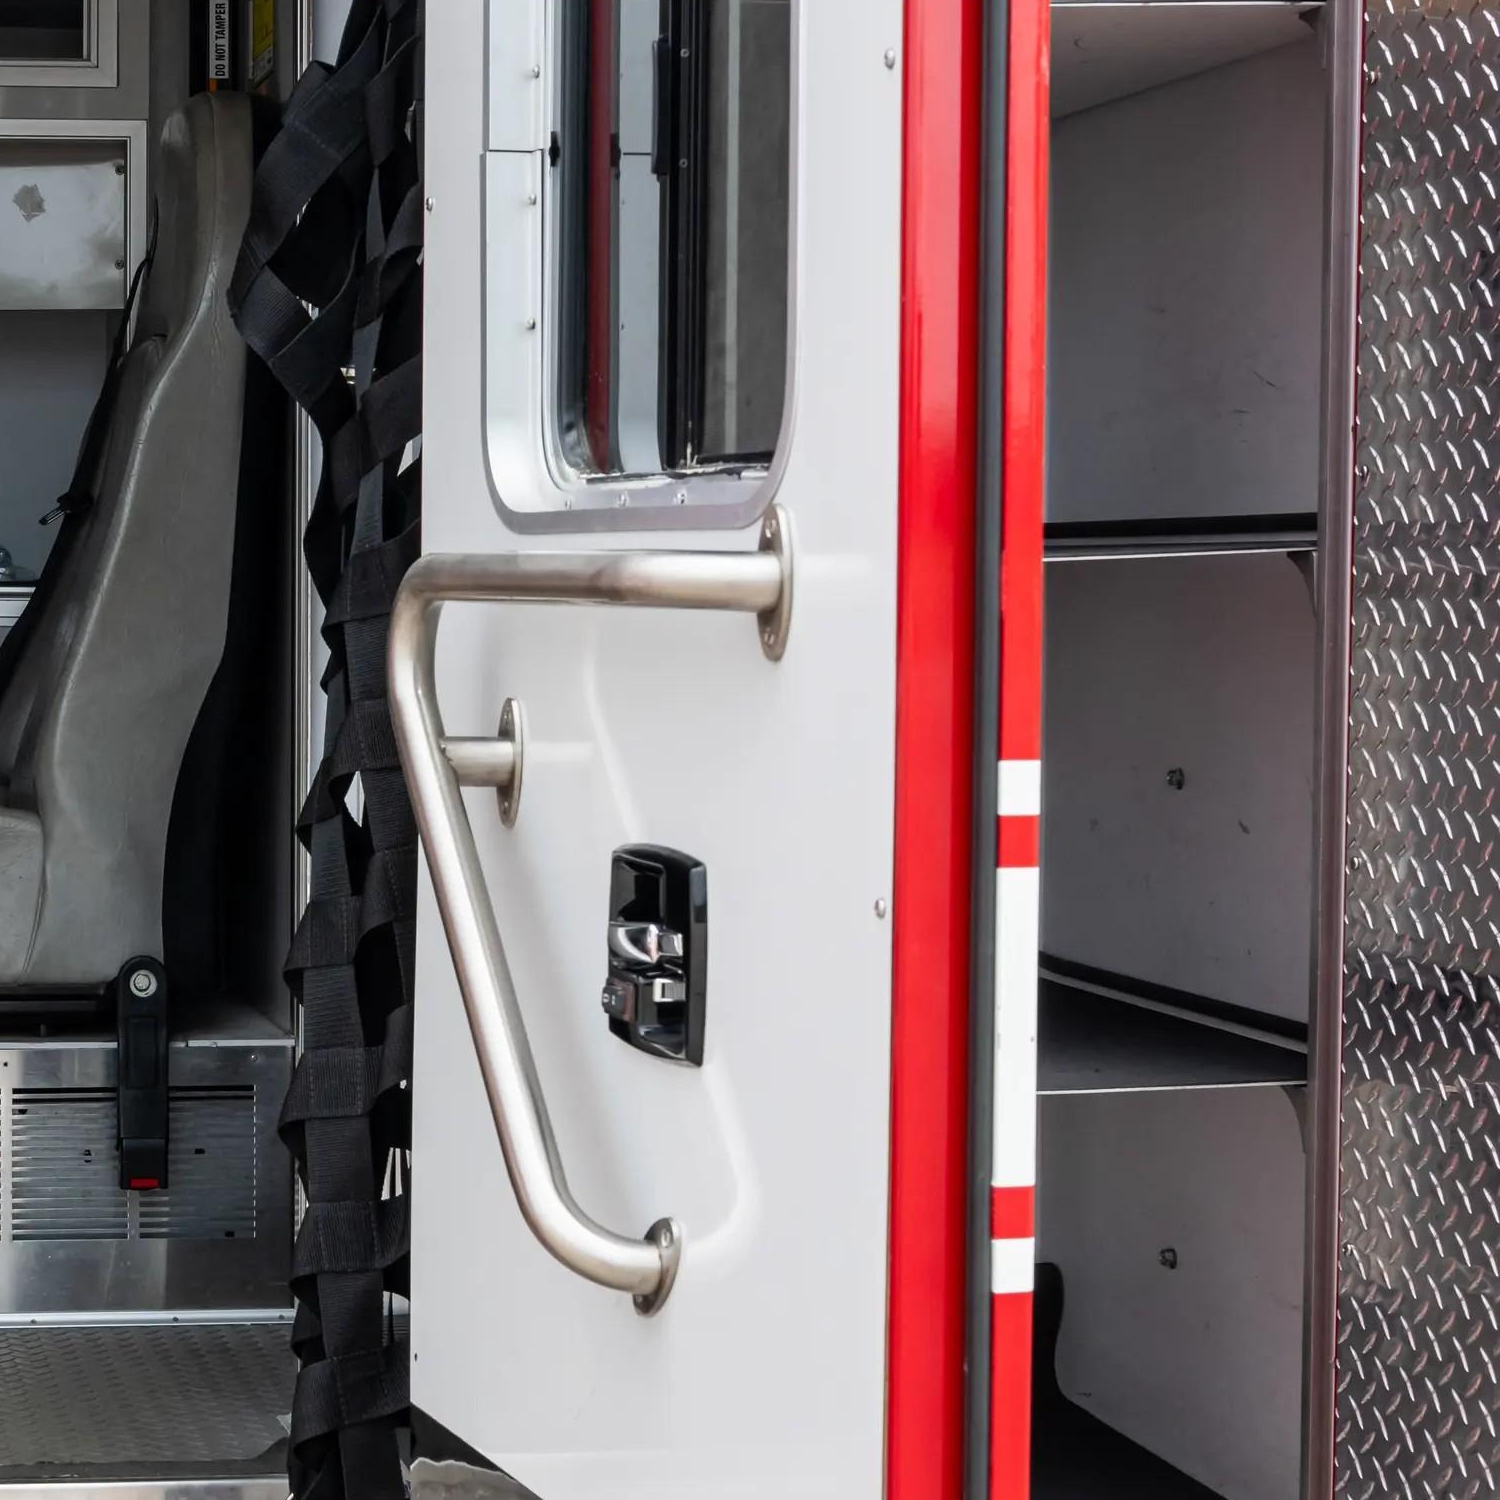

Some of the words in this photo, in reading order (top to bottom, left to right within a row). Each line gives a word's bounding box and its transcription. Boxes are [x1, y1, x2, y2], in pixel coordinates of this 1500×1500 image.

[214, 3, 226, 41] TAMPER
[214, 43, 226, 61] NOT
[214, 64, 226, 77] DO
